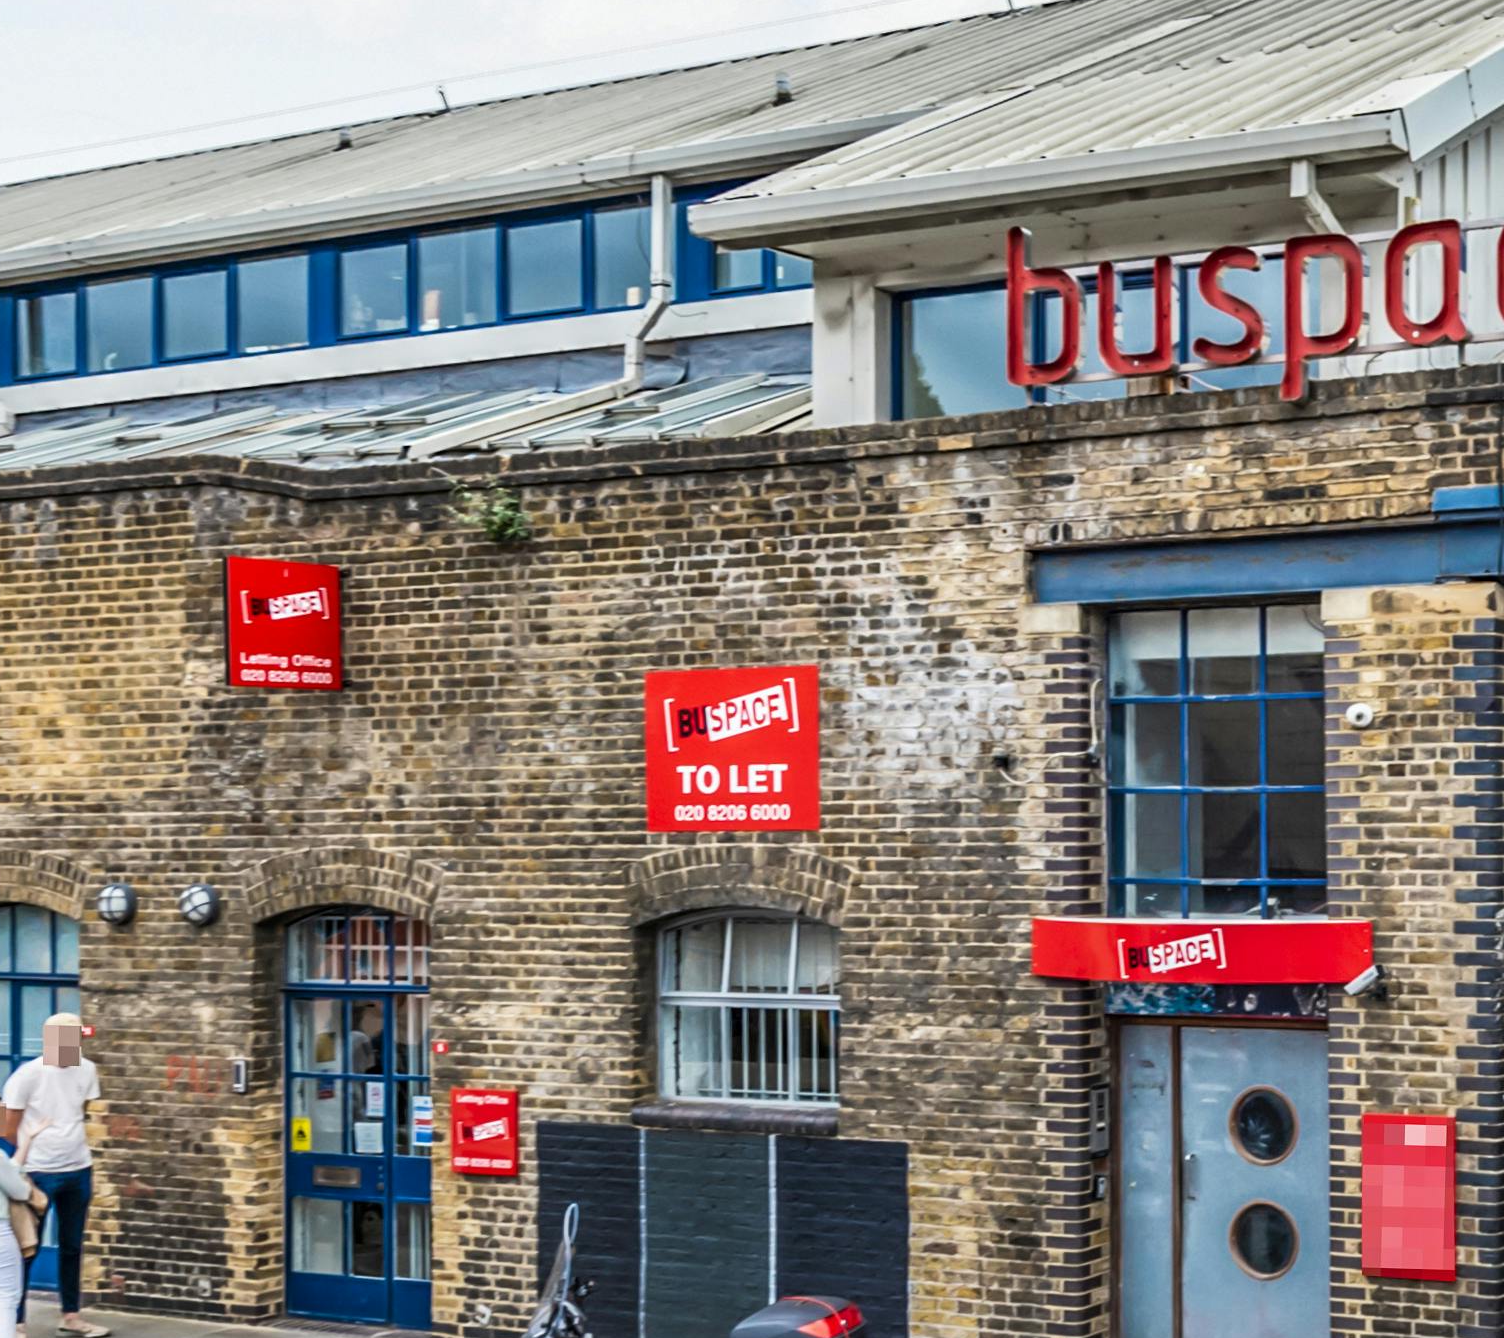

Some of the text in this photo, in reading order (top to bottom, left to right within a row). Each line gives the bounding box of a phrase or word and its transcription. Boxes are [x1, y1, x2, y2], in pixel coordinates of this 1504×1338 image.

[676, 764, 789, 794] TO LET
[674, 804, 791, 821] 020 8206 6000
